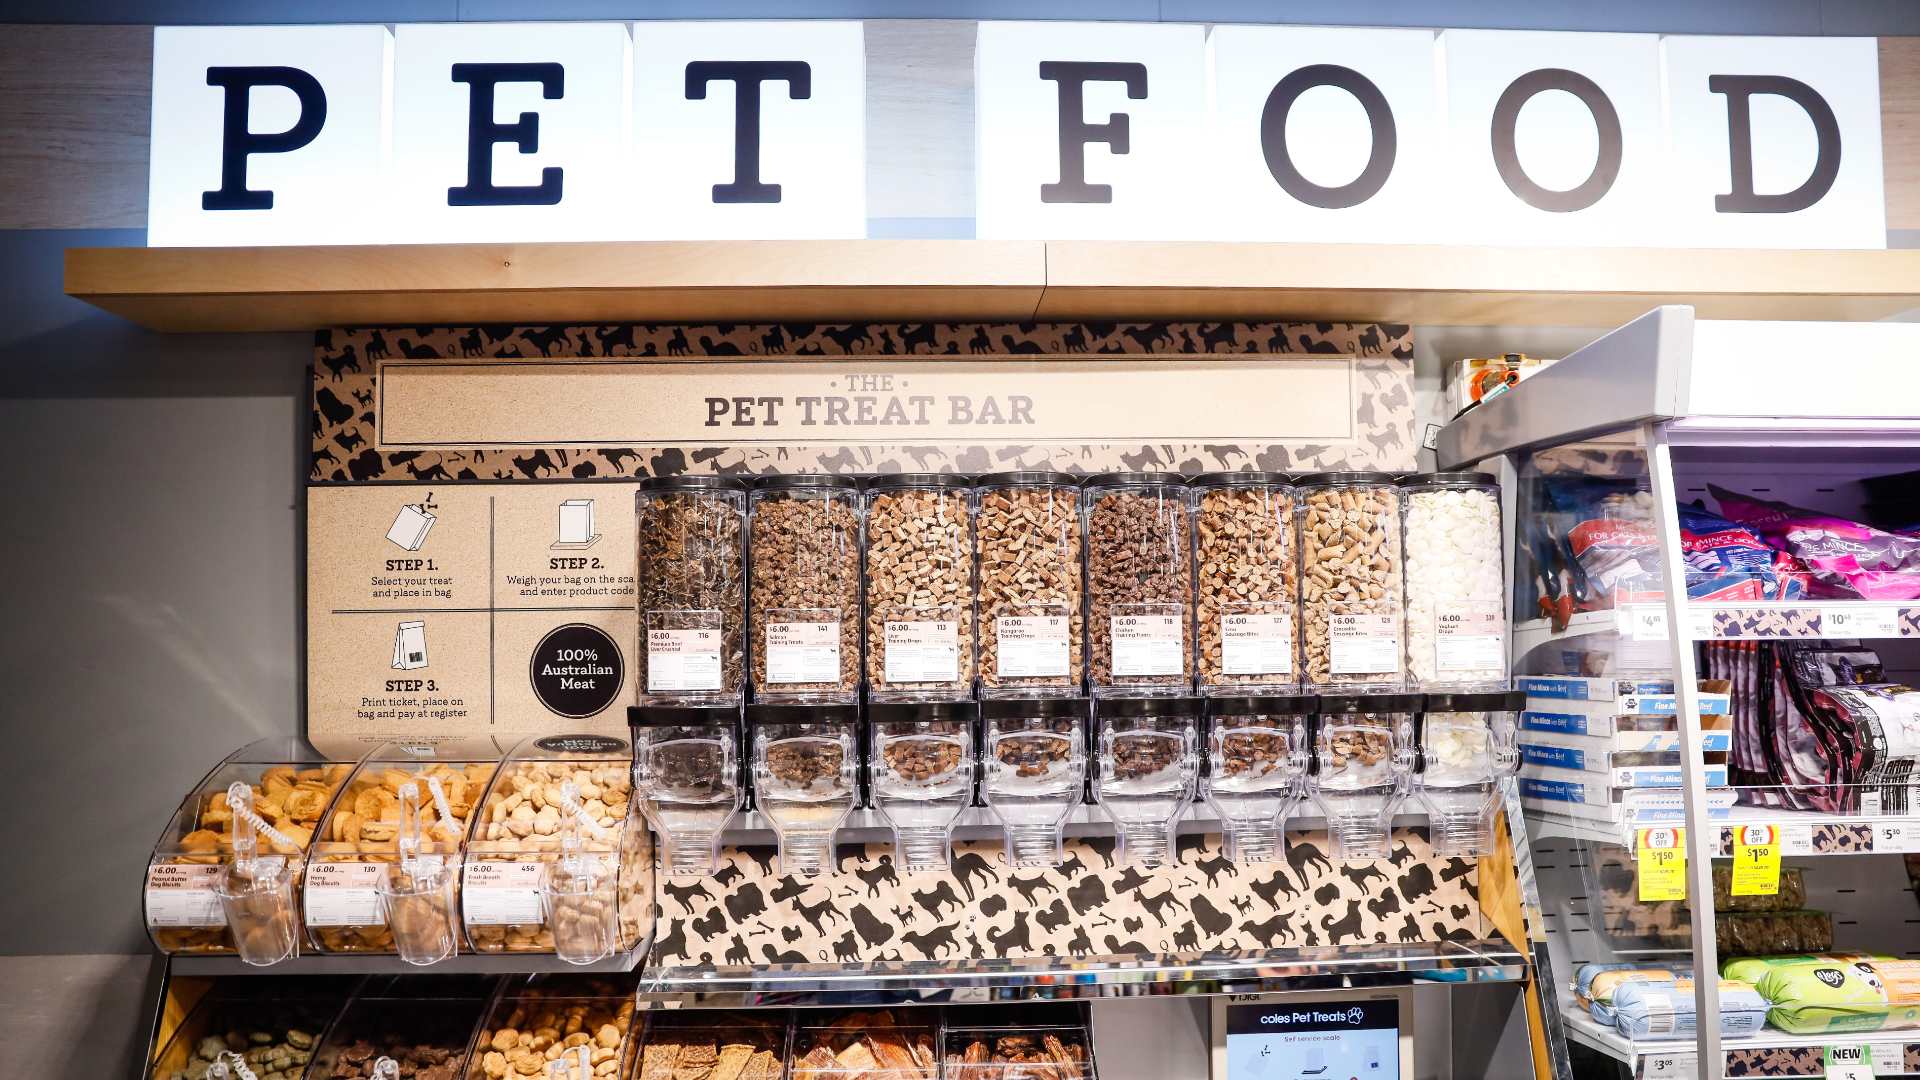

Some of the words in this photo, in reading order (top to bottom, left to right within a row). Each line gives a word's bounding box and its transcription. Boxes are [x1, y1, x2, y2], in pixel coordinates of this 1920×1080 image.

[202, 60, 812, 210] PET
[1039, 60, 1842, 214] FOOD
[844, 375, 894, 392] THE
[704, 396, 784, 426] PET
[796, 395, 935, 425] TREAT
[947, 395, 1036, 425] BAR
[385, 559, 423, 571] STEP
[426, 559, 439, 571] 1.
[549, 558, 587, 570] STEP
[590, 557, 605, 569] 2.
[371, 576, 402, 586] Select
[404, 578, 426, 588] your
[428, 576, 453, 585] treat
[506, 575, 537, 587] Weigh
[539, 577, 562, 587] your
[564, 575, 582, 586] bag
[583, 576, 596, 584] on
[599, 574, 615, 584] the
[372, 588, 391, 597] and
[393, 587, 420, 600] place
[422, 587, 432, 597] in
[434, 587, 452, 600] bag
[519, 586, 539, 596] and
[541, 587, 567, 596] enter
[569, 586, 609, 598] product
[610, 586, 635, 595] code
[557, 650, 598, 661] 100%
[541, 663, 614, 676] Australian
[385, 680, 424, 692] STEP
[426, 680, 440, 692] 3.
[560, 678, 596, 690] Meat
[361, 697, 387, 706] Print
[388, 697, 420, 708] ticket,
[422, 697, 449, 709] place
[451, 698, 464, 706] on
[357, 708, 375, 720] bag
[376, 708, 396, 718] and
[397, 710, 415, 720] pay
[418, 709, 429, 718] at
[430, 708, 468, 720] register
[1260, 1013, 1291, 1025] coles
[1292, 1012, 1311, 1024] Pet
[1312, 1010, 1346, 1023] Treats
[1832, 1048, 1861, 1060] NEW
